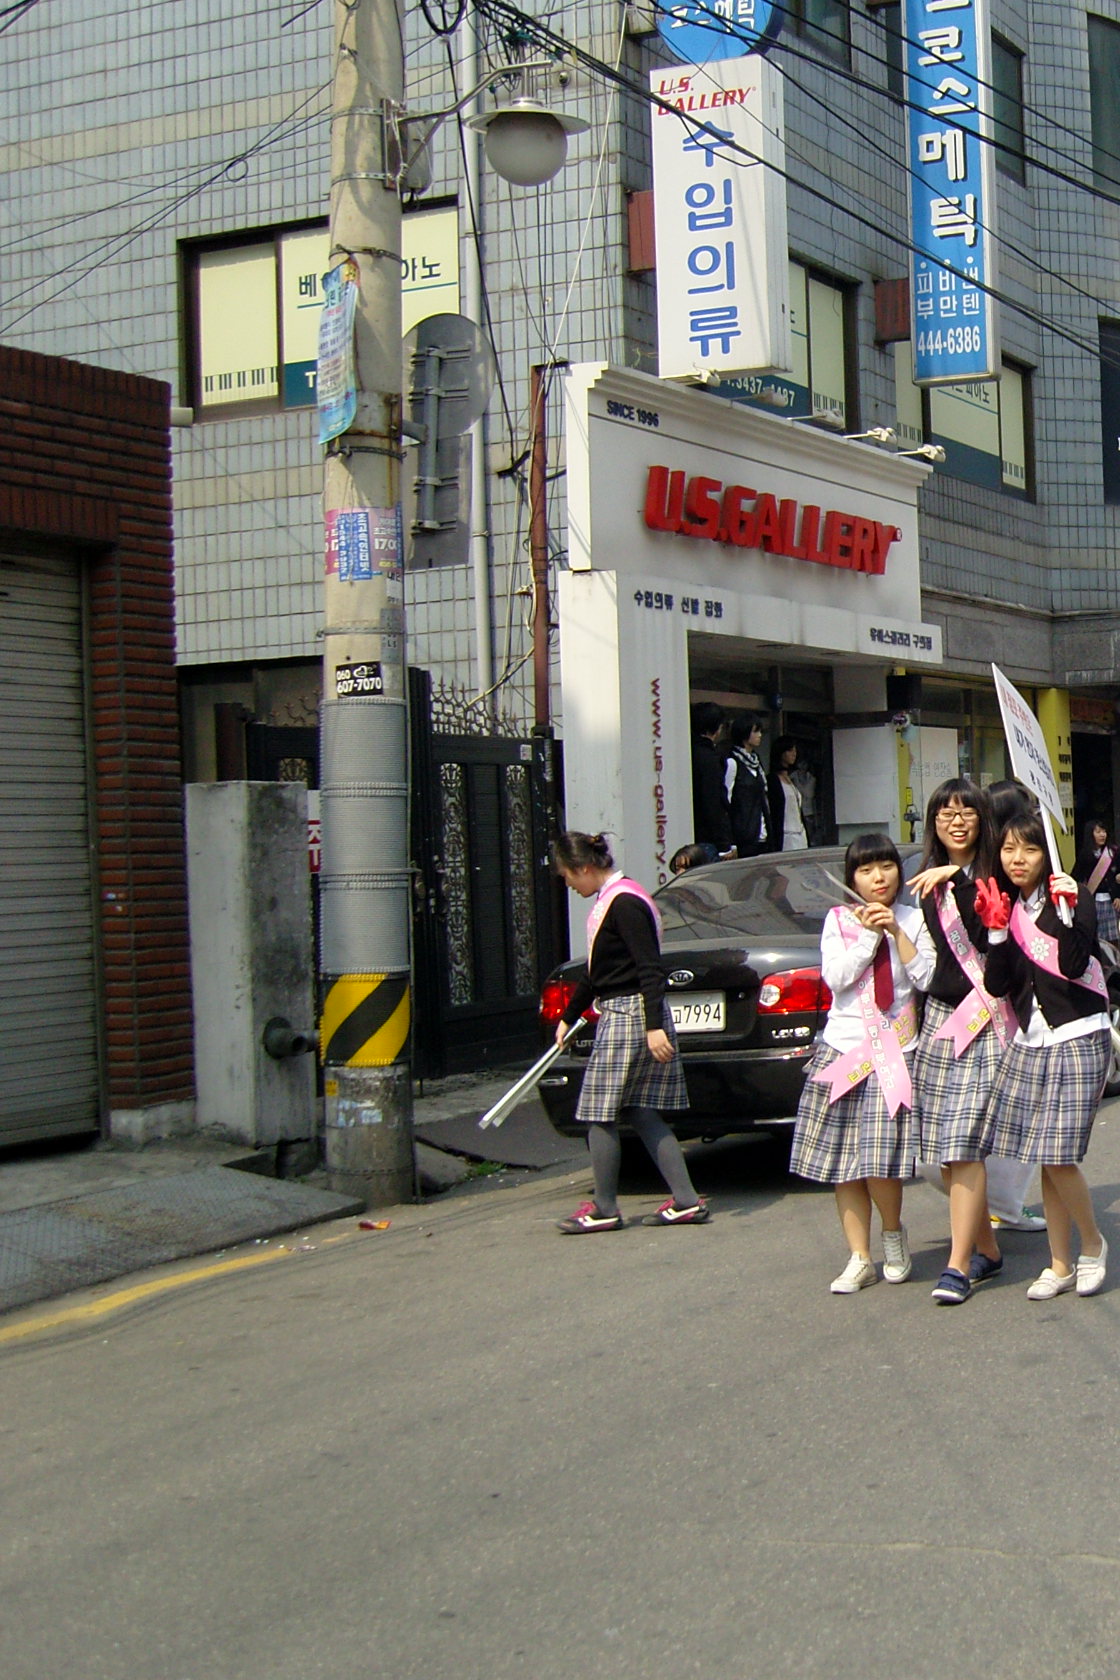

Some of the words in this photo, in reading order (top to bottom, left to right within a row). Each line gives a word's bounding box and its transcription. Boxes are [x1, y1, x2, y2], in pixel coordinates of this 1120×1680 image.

[658, 86, 752, 116] GALLERY
[917, 0, 976, 247] 코스메틱
[682, 120, 741, 357] 수입의류
[606, 399, 635, 421] SINCE
[636, 408, 660, 428] 1996
[634, 590, 673, 611] 수입의류
[337, 677, 382, 693] 607-7070
[671, 971, 690, 983] KIA
